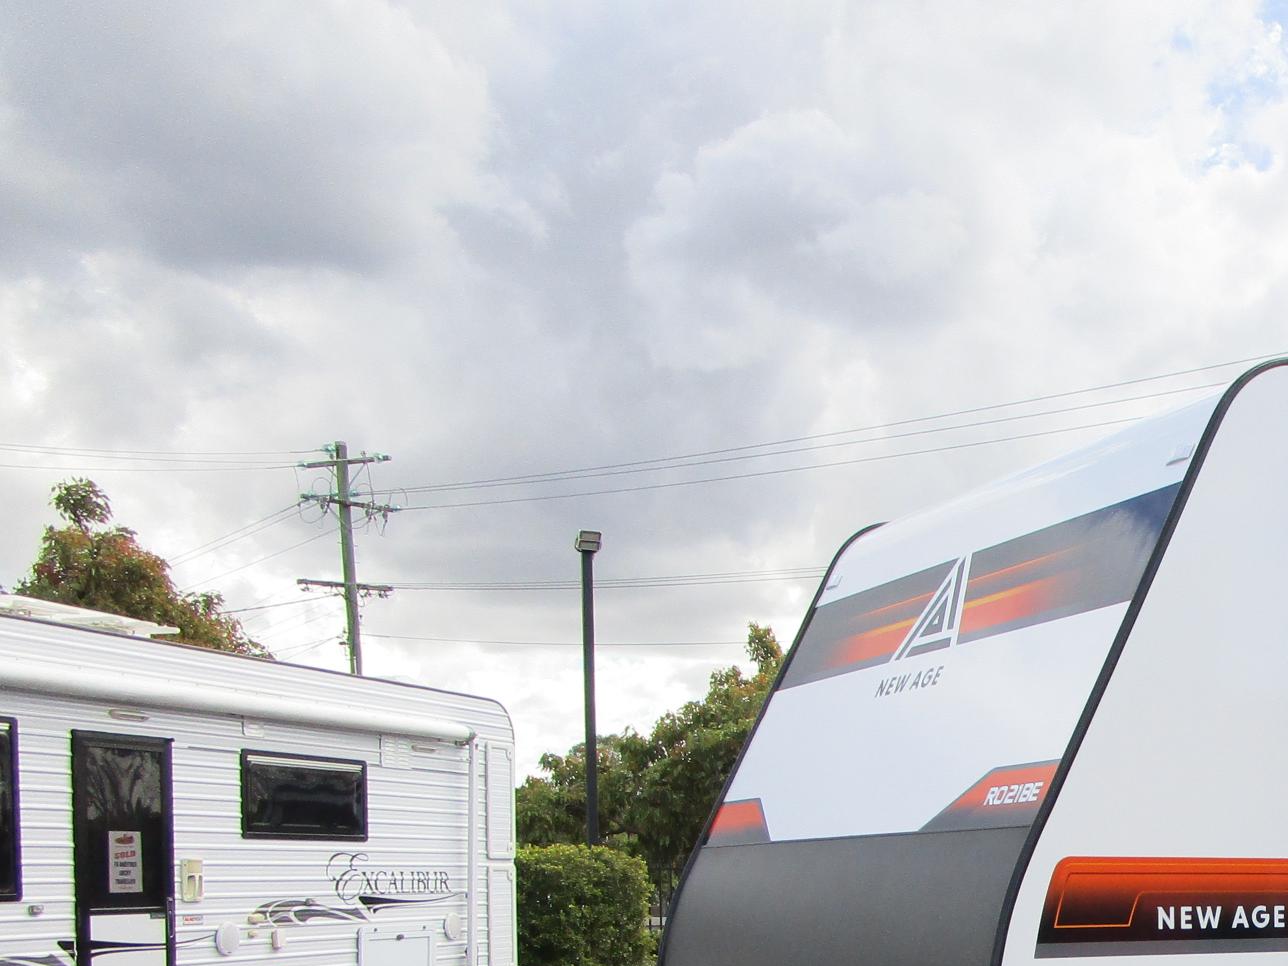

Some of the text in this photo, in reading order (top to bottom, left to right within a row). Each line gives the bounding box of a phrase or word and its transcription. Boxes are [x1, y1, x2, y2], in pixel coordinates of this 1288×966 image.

[874, 665, 945, 698] NEW AGE
[1156, 905, 1286, 930] NEW AGE
